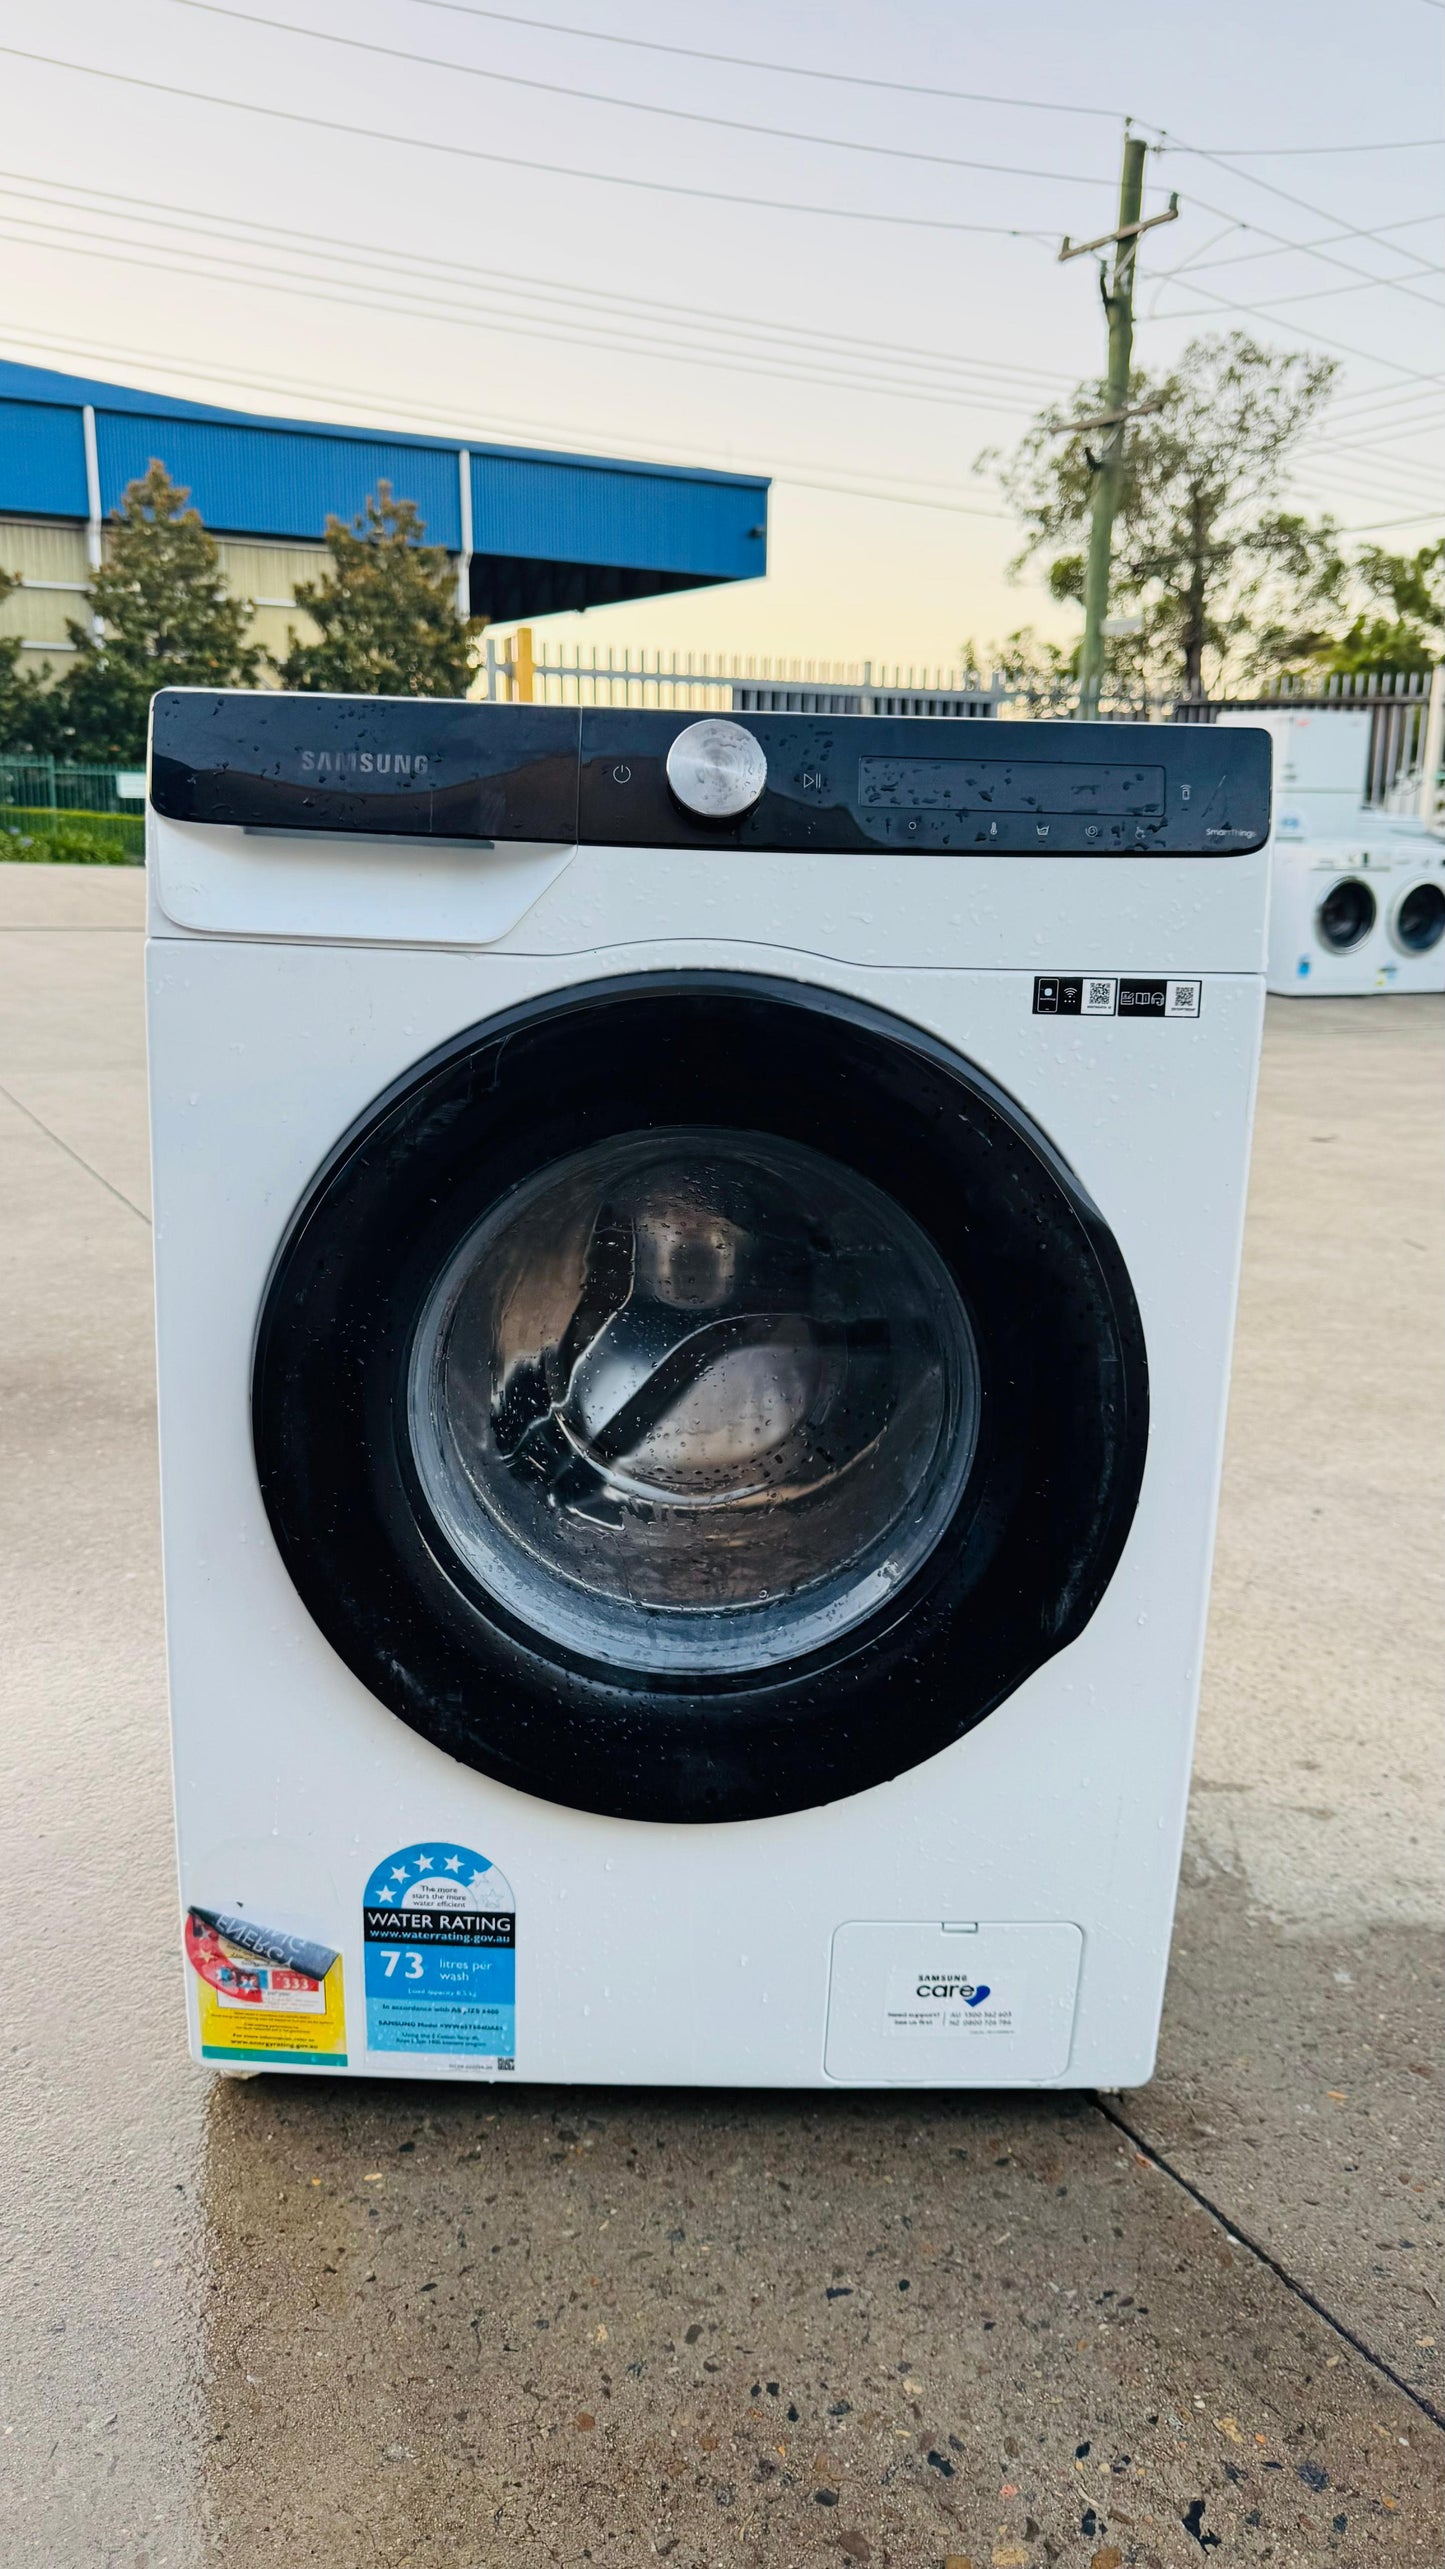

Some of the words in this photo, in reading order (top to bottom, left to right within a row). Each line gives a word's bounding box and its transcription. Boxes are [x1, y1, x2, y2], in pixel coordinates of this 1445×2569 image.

[301, 750, 429, 775] SAMSUNG
[421, 1885, 436, 1893] The
[437, 1886, 458, 1894] more
[367, 1912, 433, 1928] WATER
[440, 1915, 511, 1931] RATING
[370, 1930, 510, 1944] www.waterrating.gov.au
[380, 1950, 424, 1979] 73
[440, 1959, 468, 1970] litres
[472, 1962, 493, 1972] per
[440, 1971, 470, 1981] wash
[283, 1977, 309, 1990] 333
[916, 1984, 975, 1998] care
